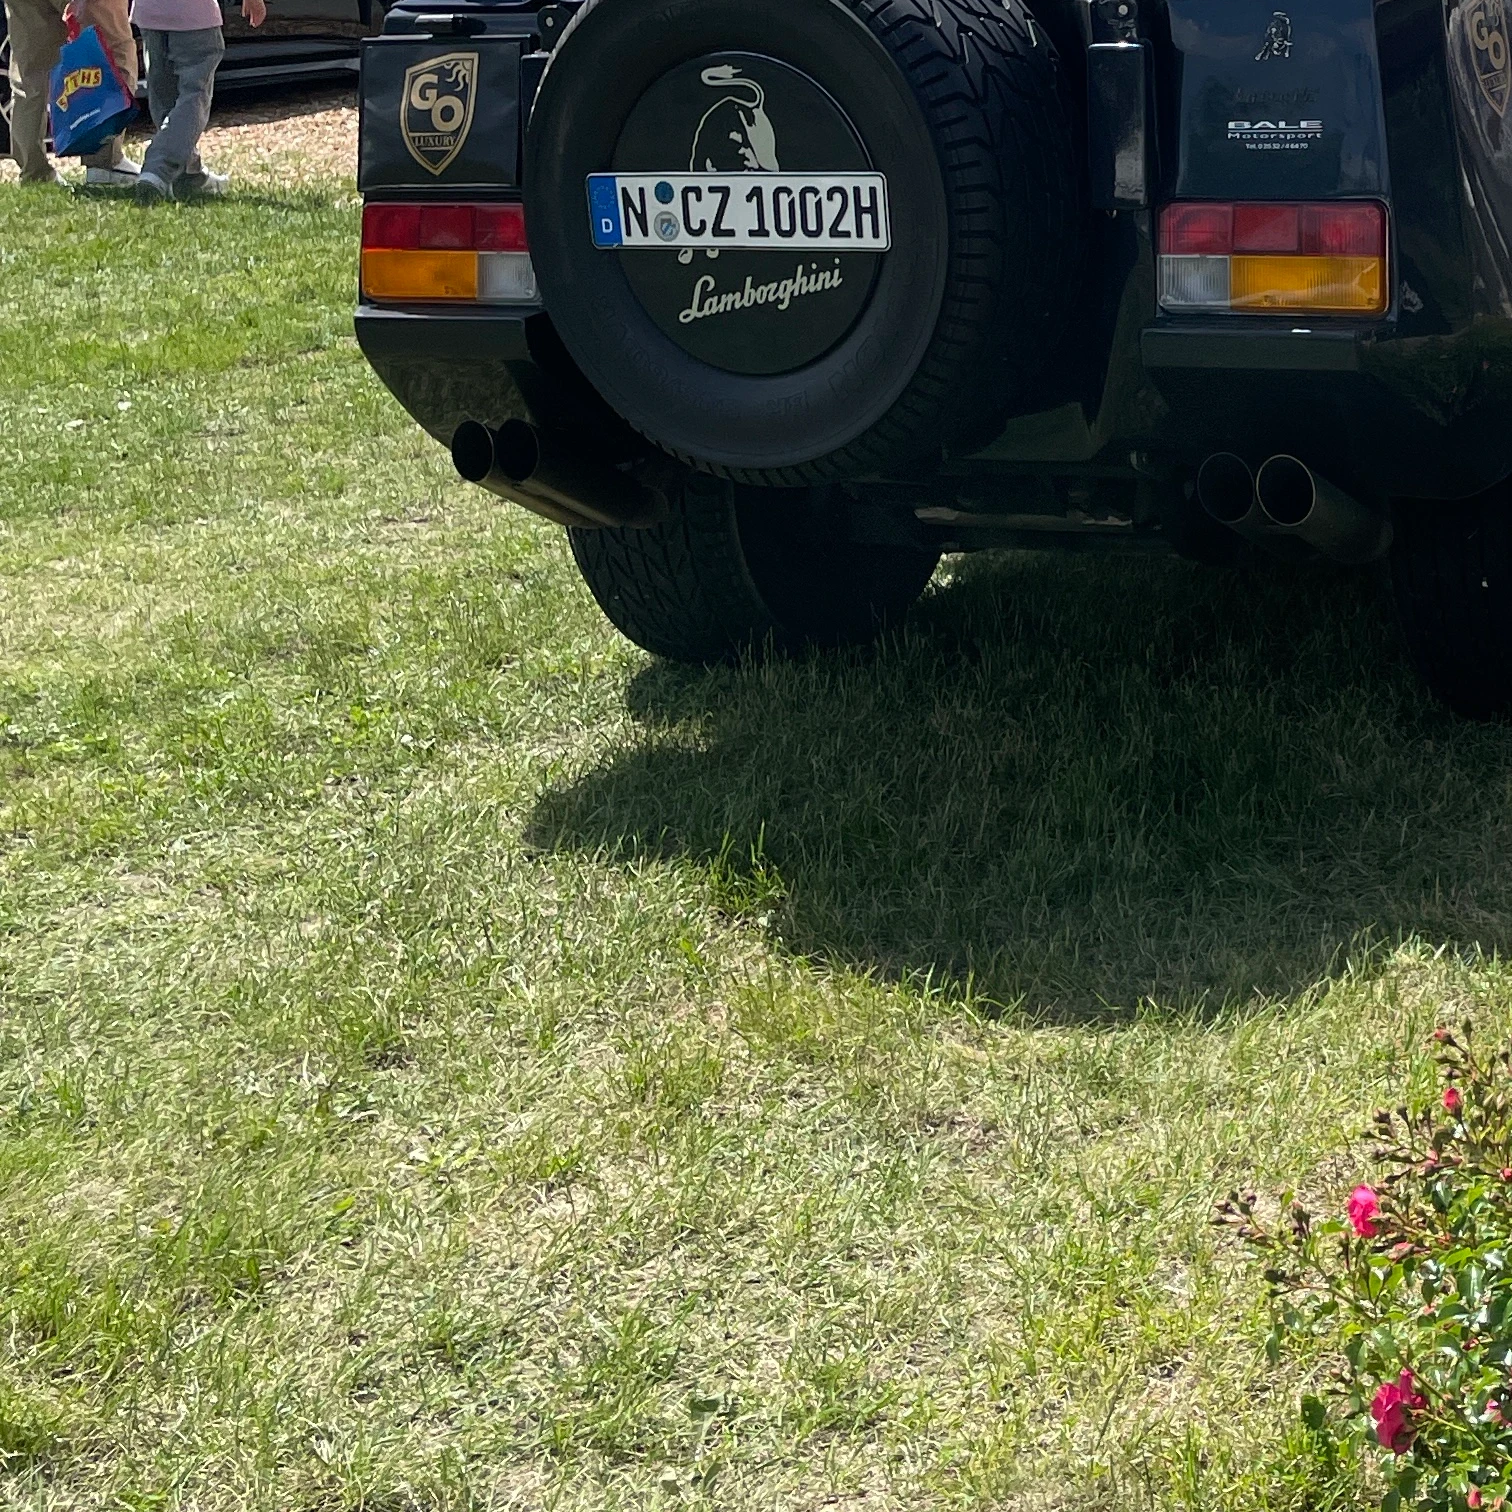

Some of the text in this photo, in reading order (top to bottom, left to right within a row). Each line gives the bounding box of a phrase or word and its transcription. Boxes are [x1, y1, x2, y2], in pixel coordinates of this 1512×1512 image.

[1472, 11, 1506, 70] GO
[411, 73, 465, 132] GO
[415, 135, 457, 147] LUXURY
[1227, 132, 1322, 141] Motorsport
[601, 218, 614, 234] D
[621, 185, 881, 239] N CZ 1002H
[678, 257, 843, 324] Lamborghini
